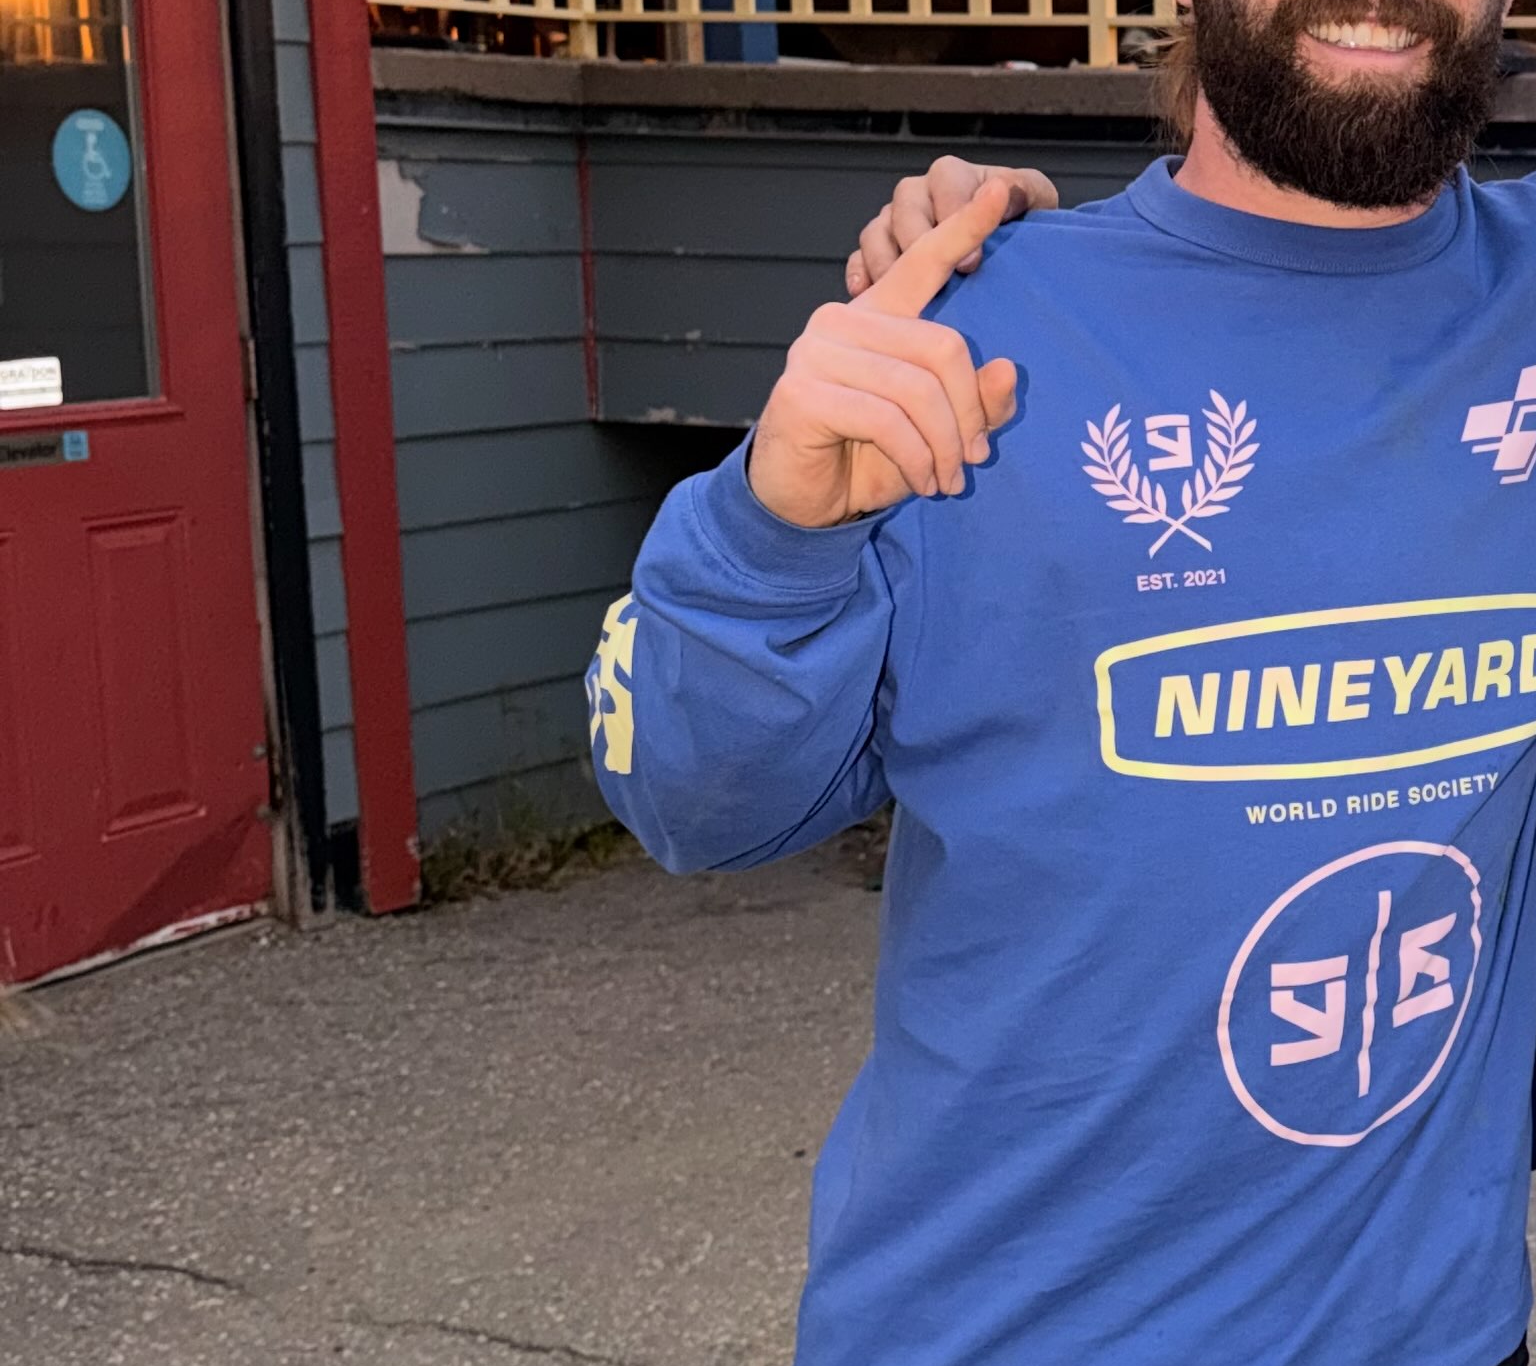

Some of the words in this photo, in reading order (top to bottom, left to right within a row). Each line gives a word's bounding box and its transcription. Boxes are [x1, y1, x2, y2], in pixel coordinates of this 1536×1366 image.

[1136, 572, 1179, 592] EST.
[1183, 568, 1226, 588] 2021
[1245, 798, 1338, 825] WORLD
[1346, 790, 1401, 815] RIDE
[1407, 771, 1500, 806] SOCIETY
